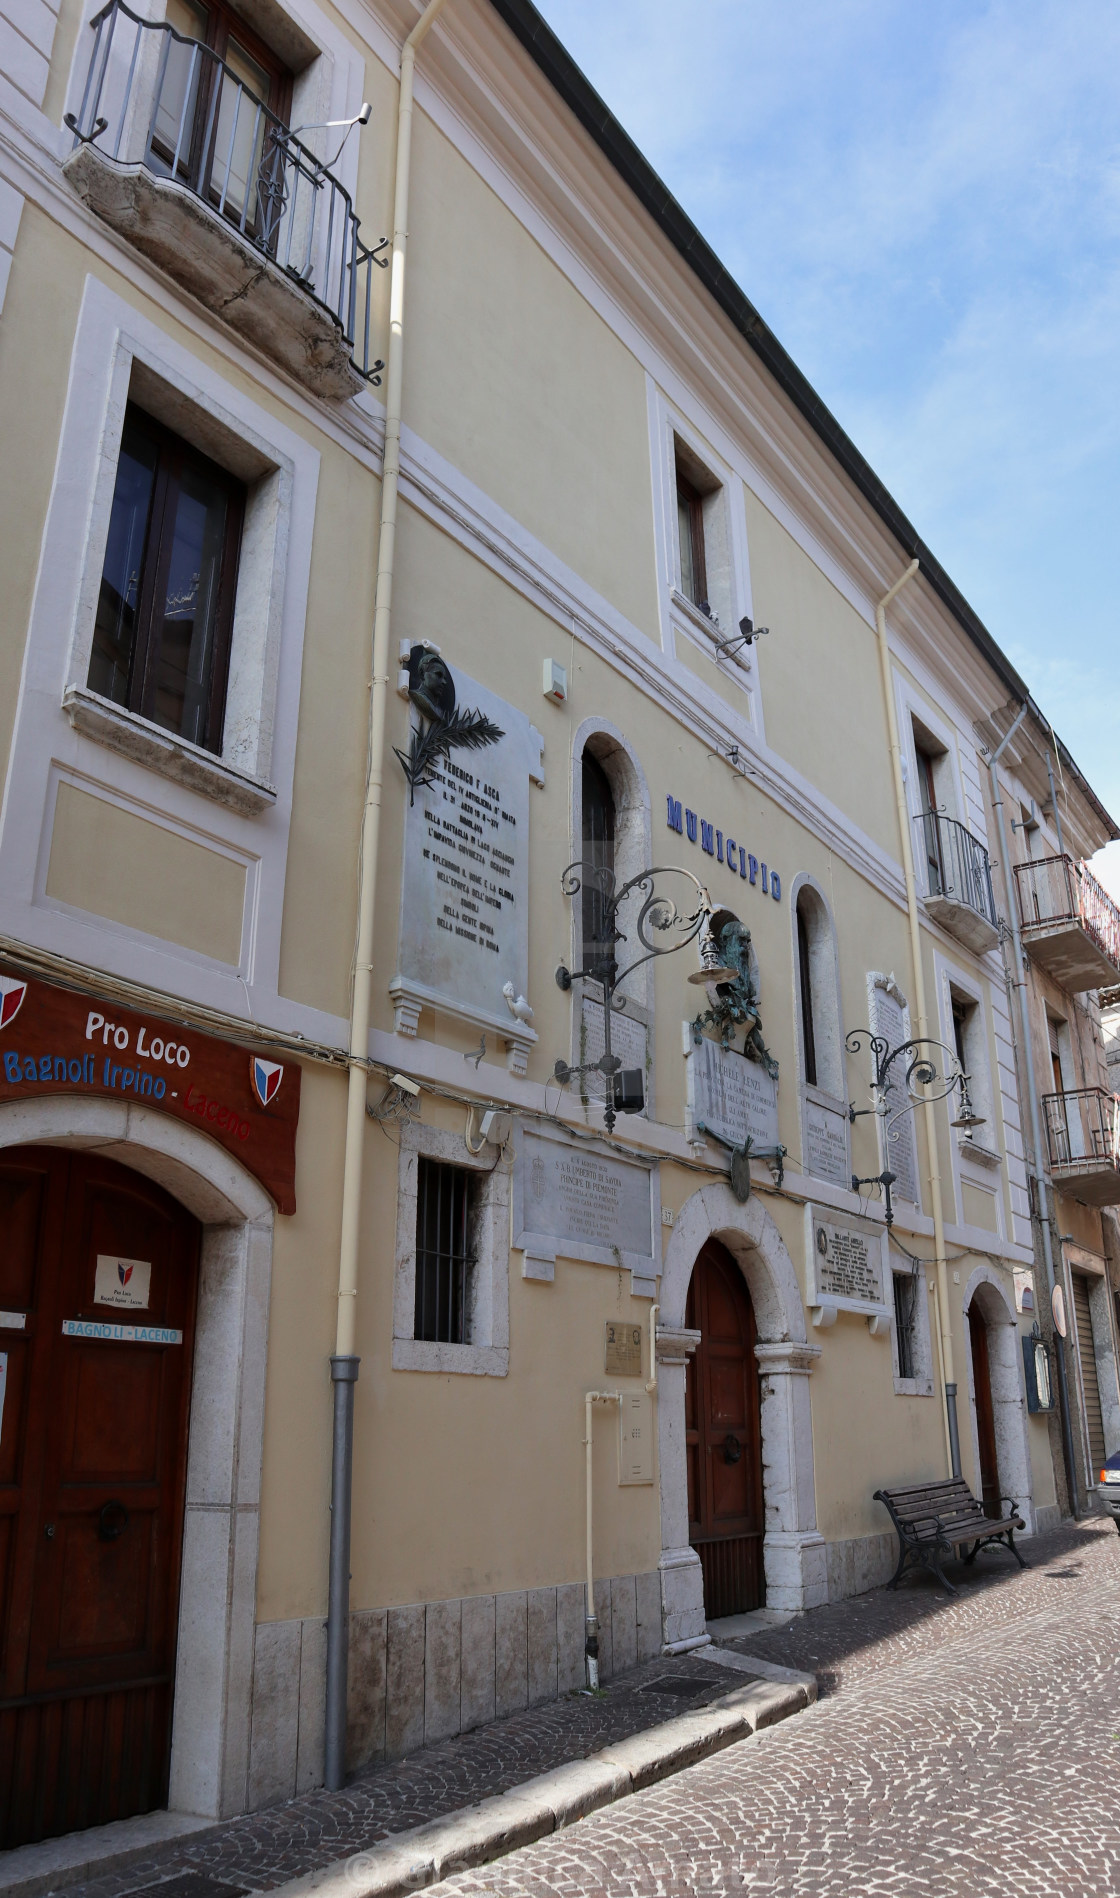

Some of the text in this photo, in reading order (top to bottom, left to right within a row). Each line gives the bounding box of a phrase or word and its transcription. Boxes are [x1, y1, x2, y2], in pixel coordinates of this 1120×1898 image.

[447, 779, 456, 790] DEL
[443, 820, 468, 840] BATTAGLIA
[666, 793, 781, 901] MUNICIPIO
[85, 1011, 190, 1068] Pro Loco
[3, 1050, 95, 1084] Bagnoli
[103, 1057, 166, 1100] Irpino
[183, 1082, 250, 1141] Laceno
[592, 1182, 616, 1196] PIEMONTE
[664, 1209, 672, 1222] 37
[134, 1329, 178, 1342] LACENO
